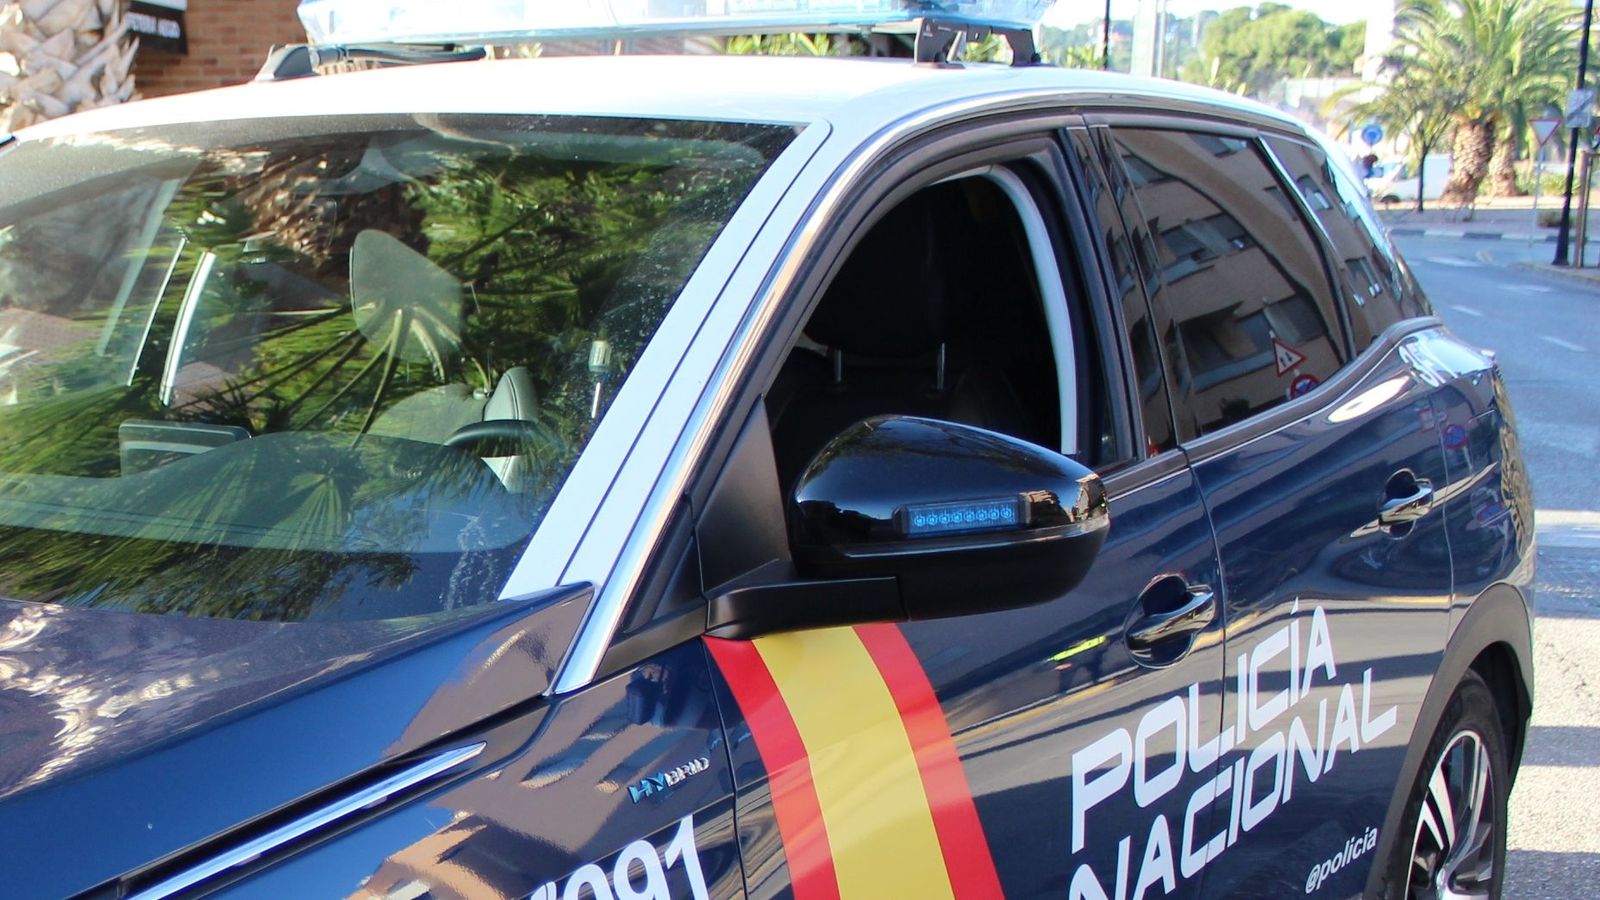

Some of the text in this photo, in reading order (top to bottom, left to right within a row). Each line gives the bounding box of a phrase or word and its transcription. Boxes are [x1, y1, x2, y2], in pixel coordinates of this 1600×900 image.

[628, 757, 710, 804] HYBRID
[1068, 667, 1398, 900] NACIONAL
[1071, 596, 1337, 854] POLICÍA
[1304, 826, 1378, 895] @policia
